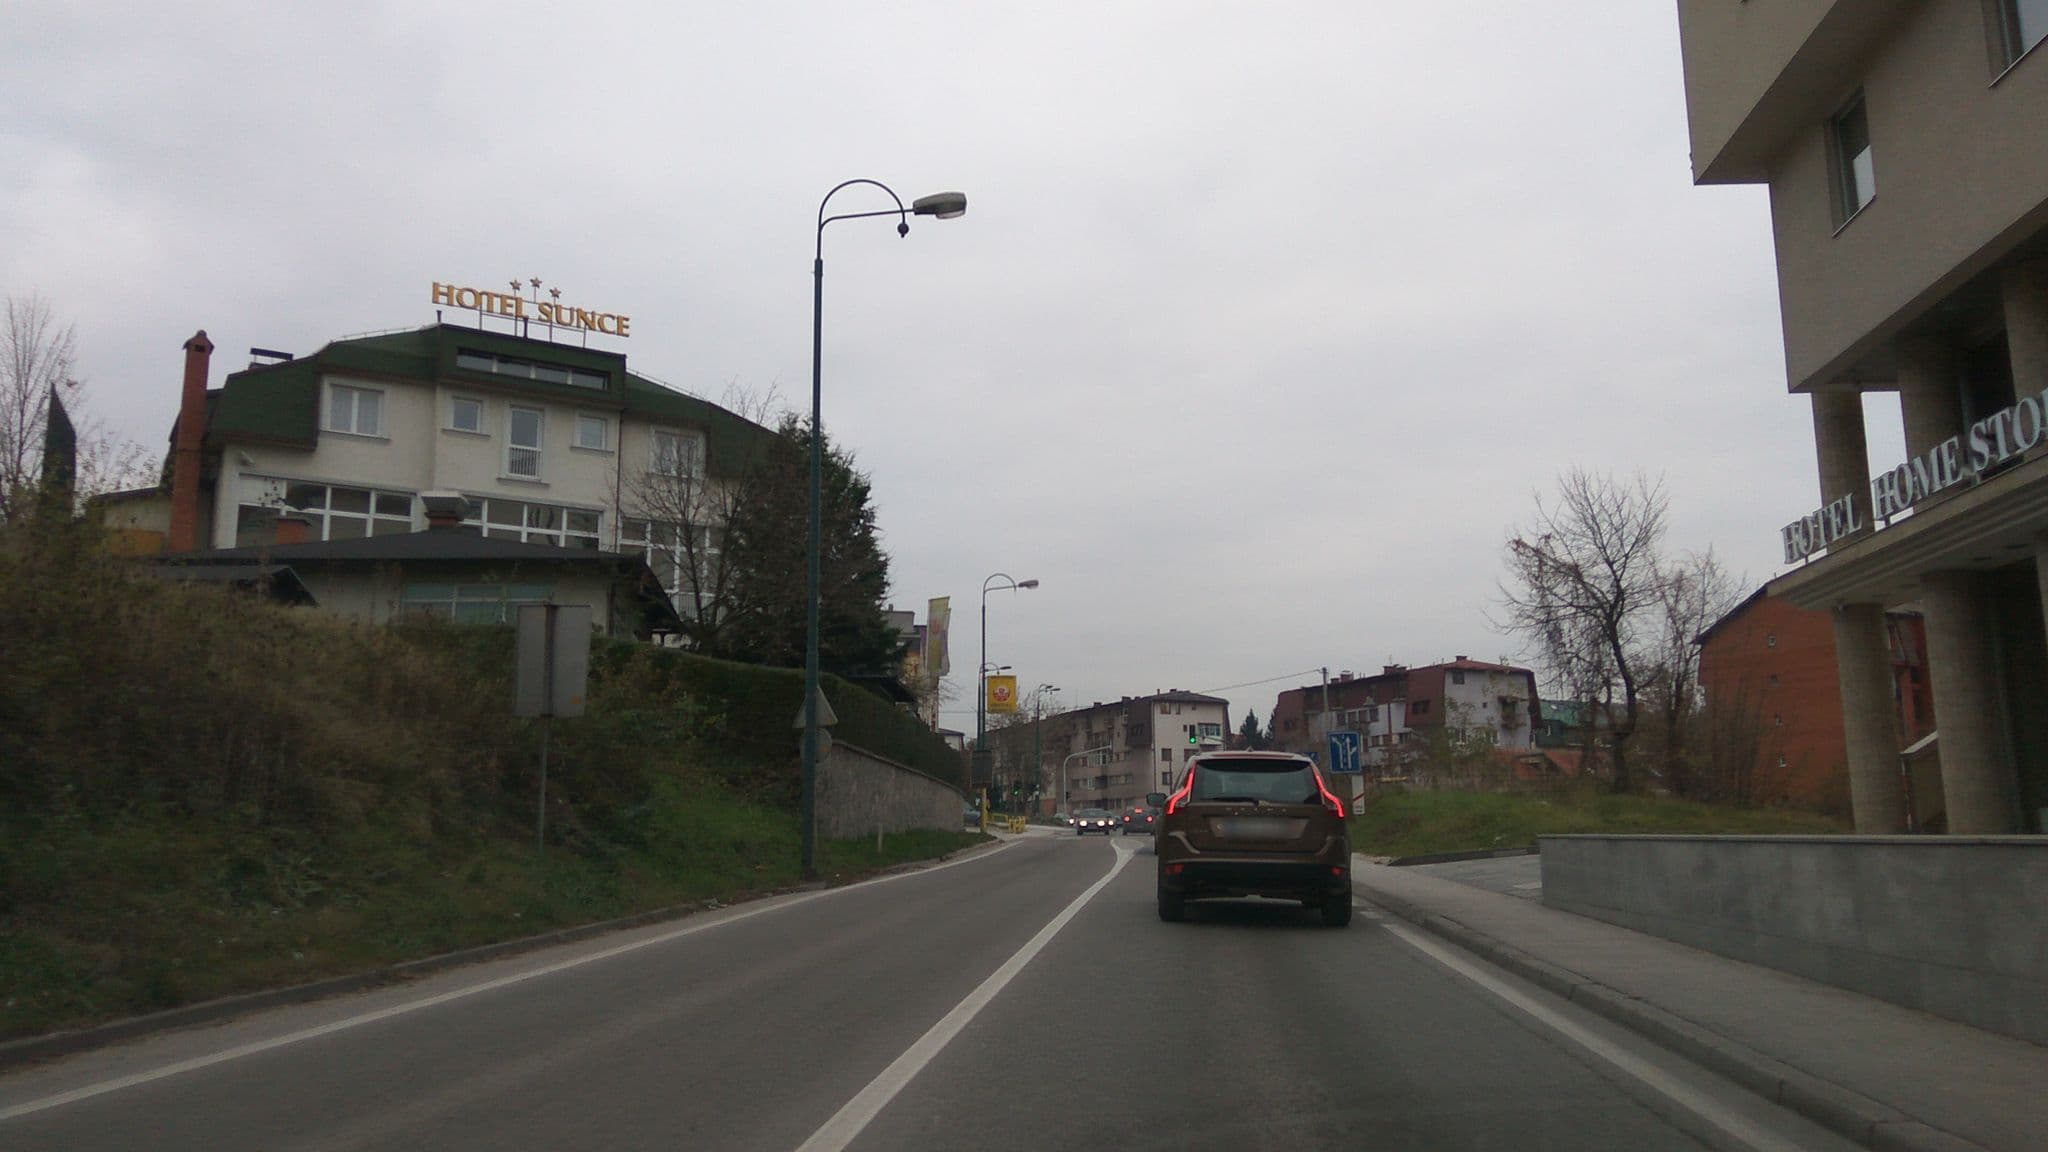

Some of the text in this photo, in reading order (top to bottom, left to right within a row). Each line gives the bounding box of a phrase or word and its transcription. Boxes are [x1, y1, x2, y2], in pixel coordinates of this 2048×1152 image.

[432, 282, 631, 337] HOTEL SUNCE
[1781, 493, 1863, 565] HOTEL
[1872, 436, 1964, 520] HOME
